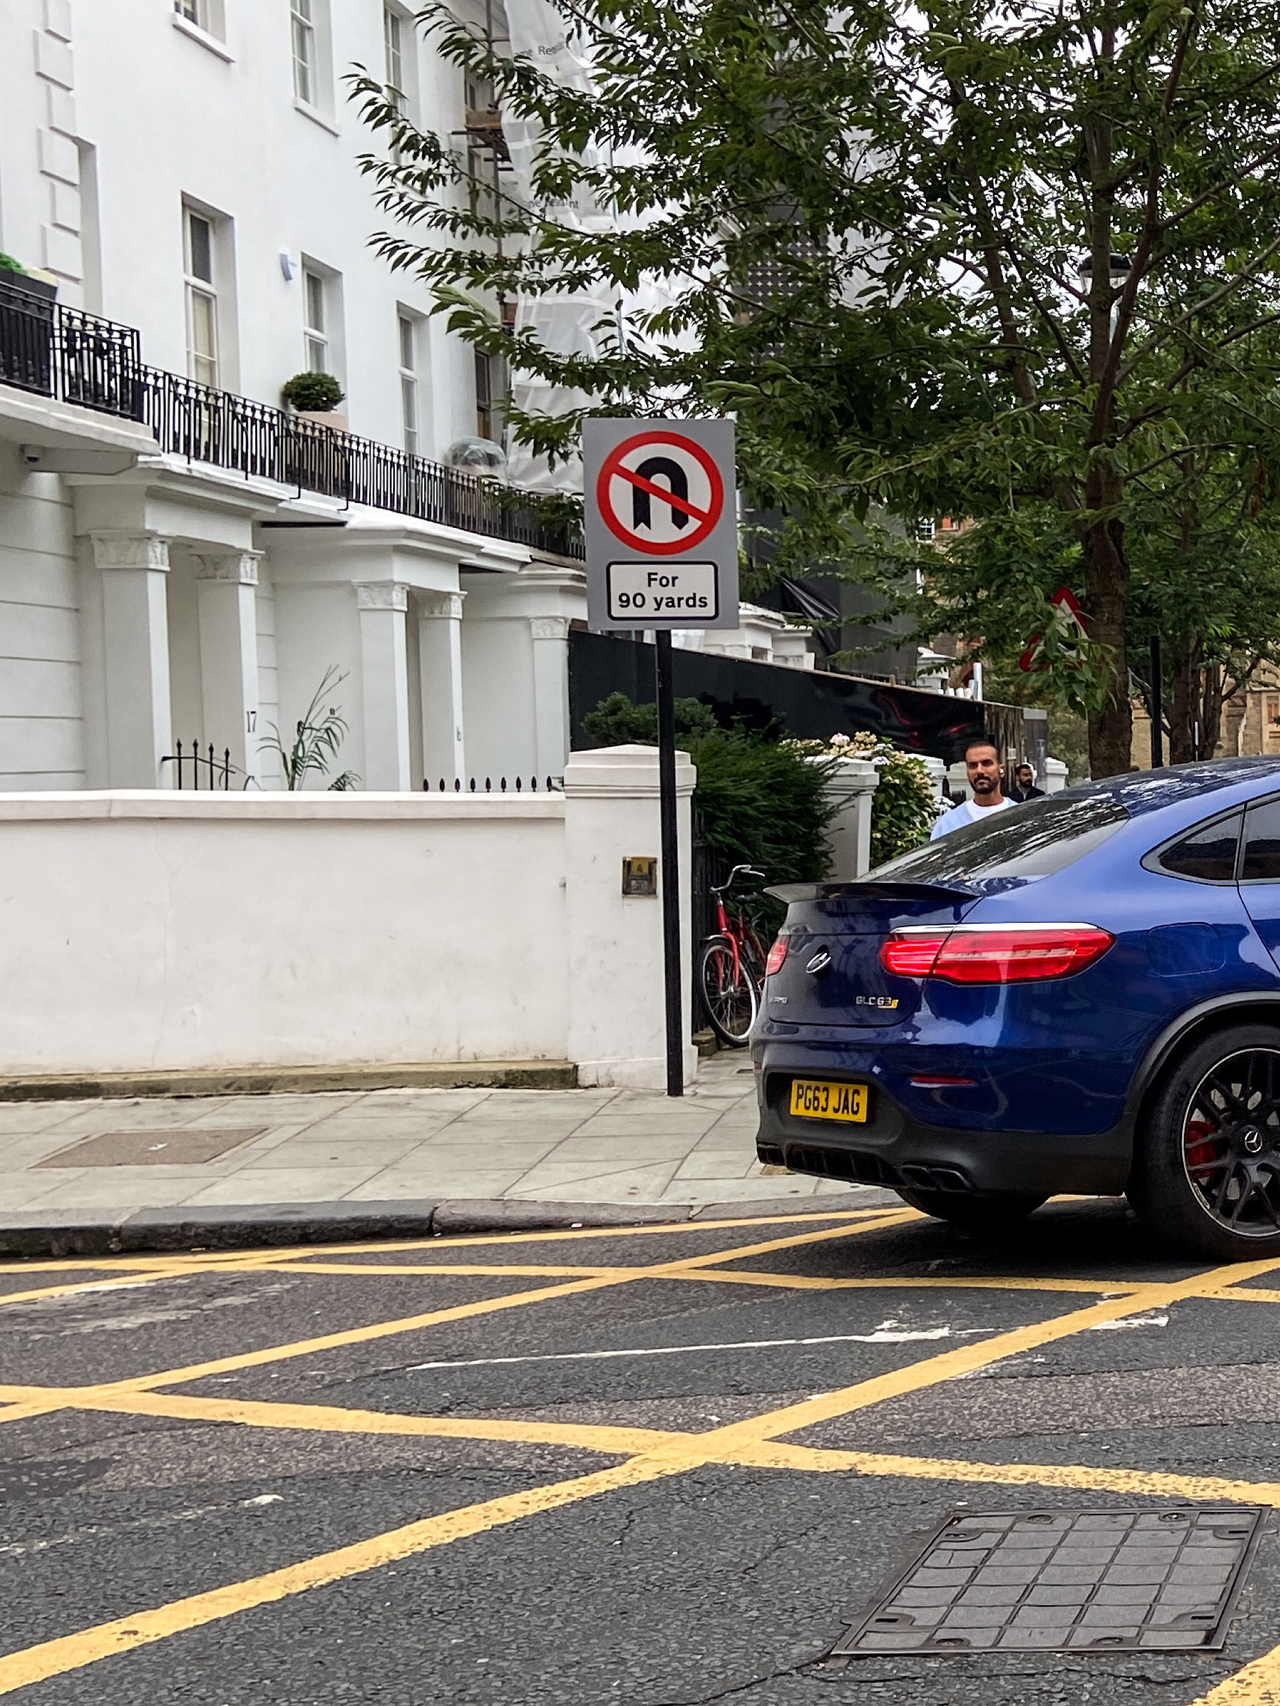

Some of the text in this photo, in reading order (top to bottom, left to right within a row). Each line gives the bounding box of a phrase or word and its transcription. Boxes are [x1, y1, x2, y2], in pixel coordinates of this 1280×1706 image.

[647, 572, 678, 588] For
[618, 592, 708, 611] 90 yards
[246, 711, 256, 733] 17
[795, 1083, 861, 1116] PG63 JAG
